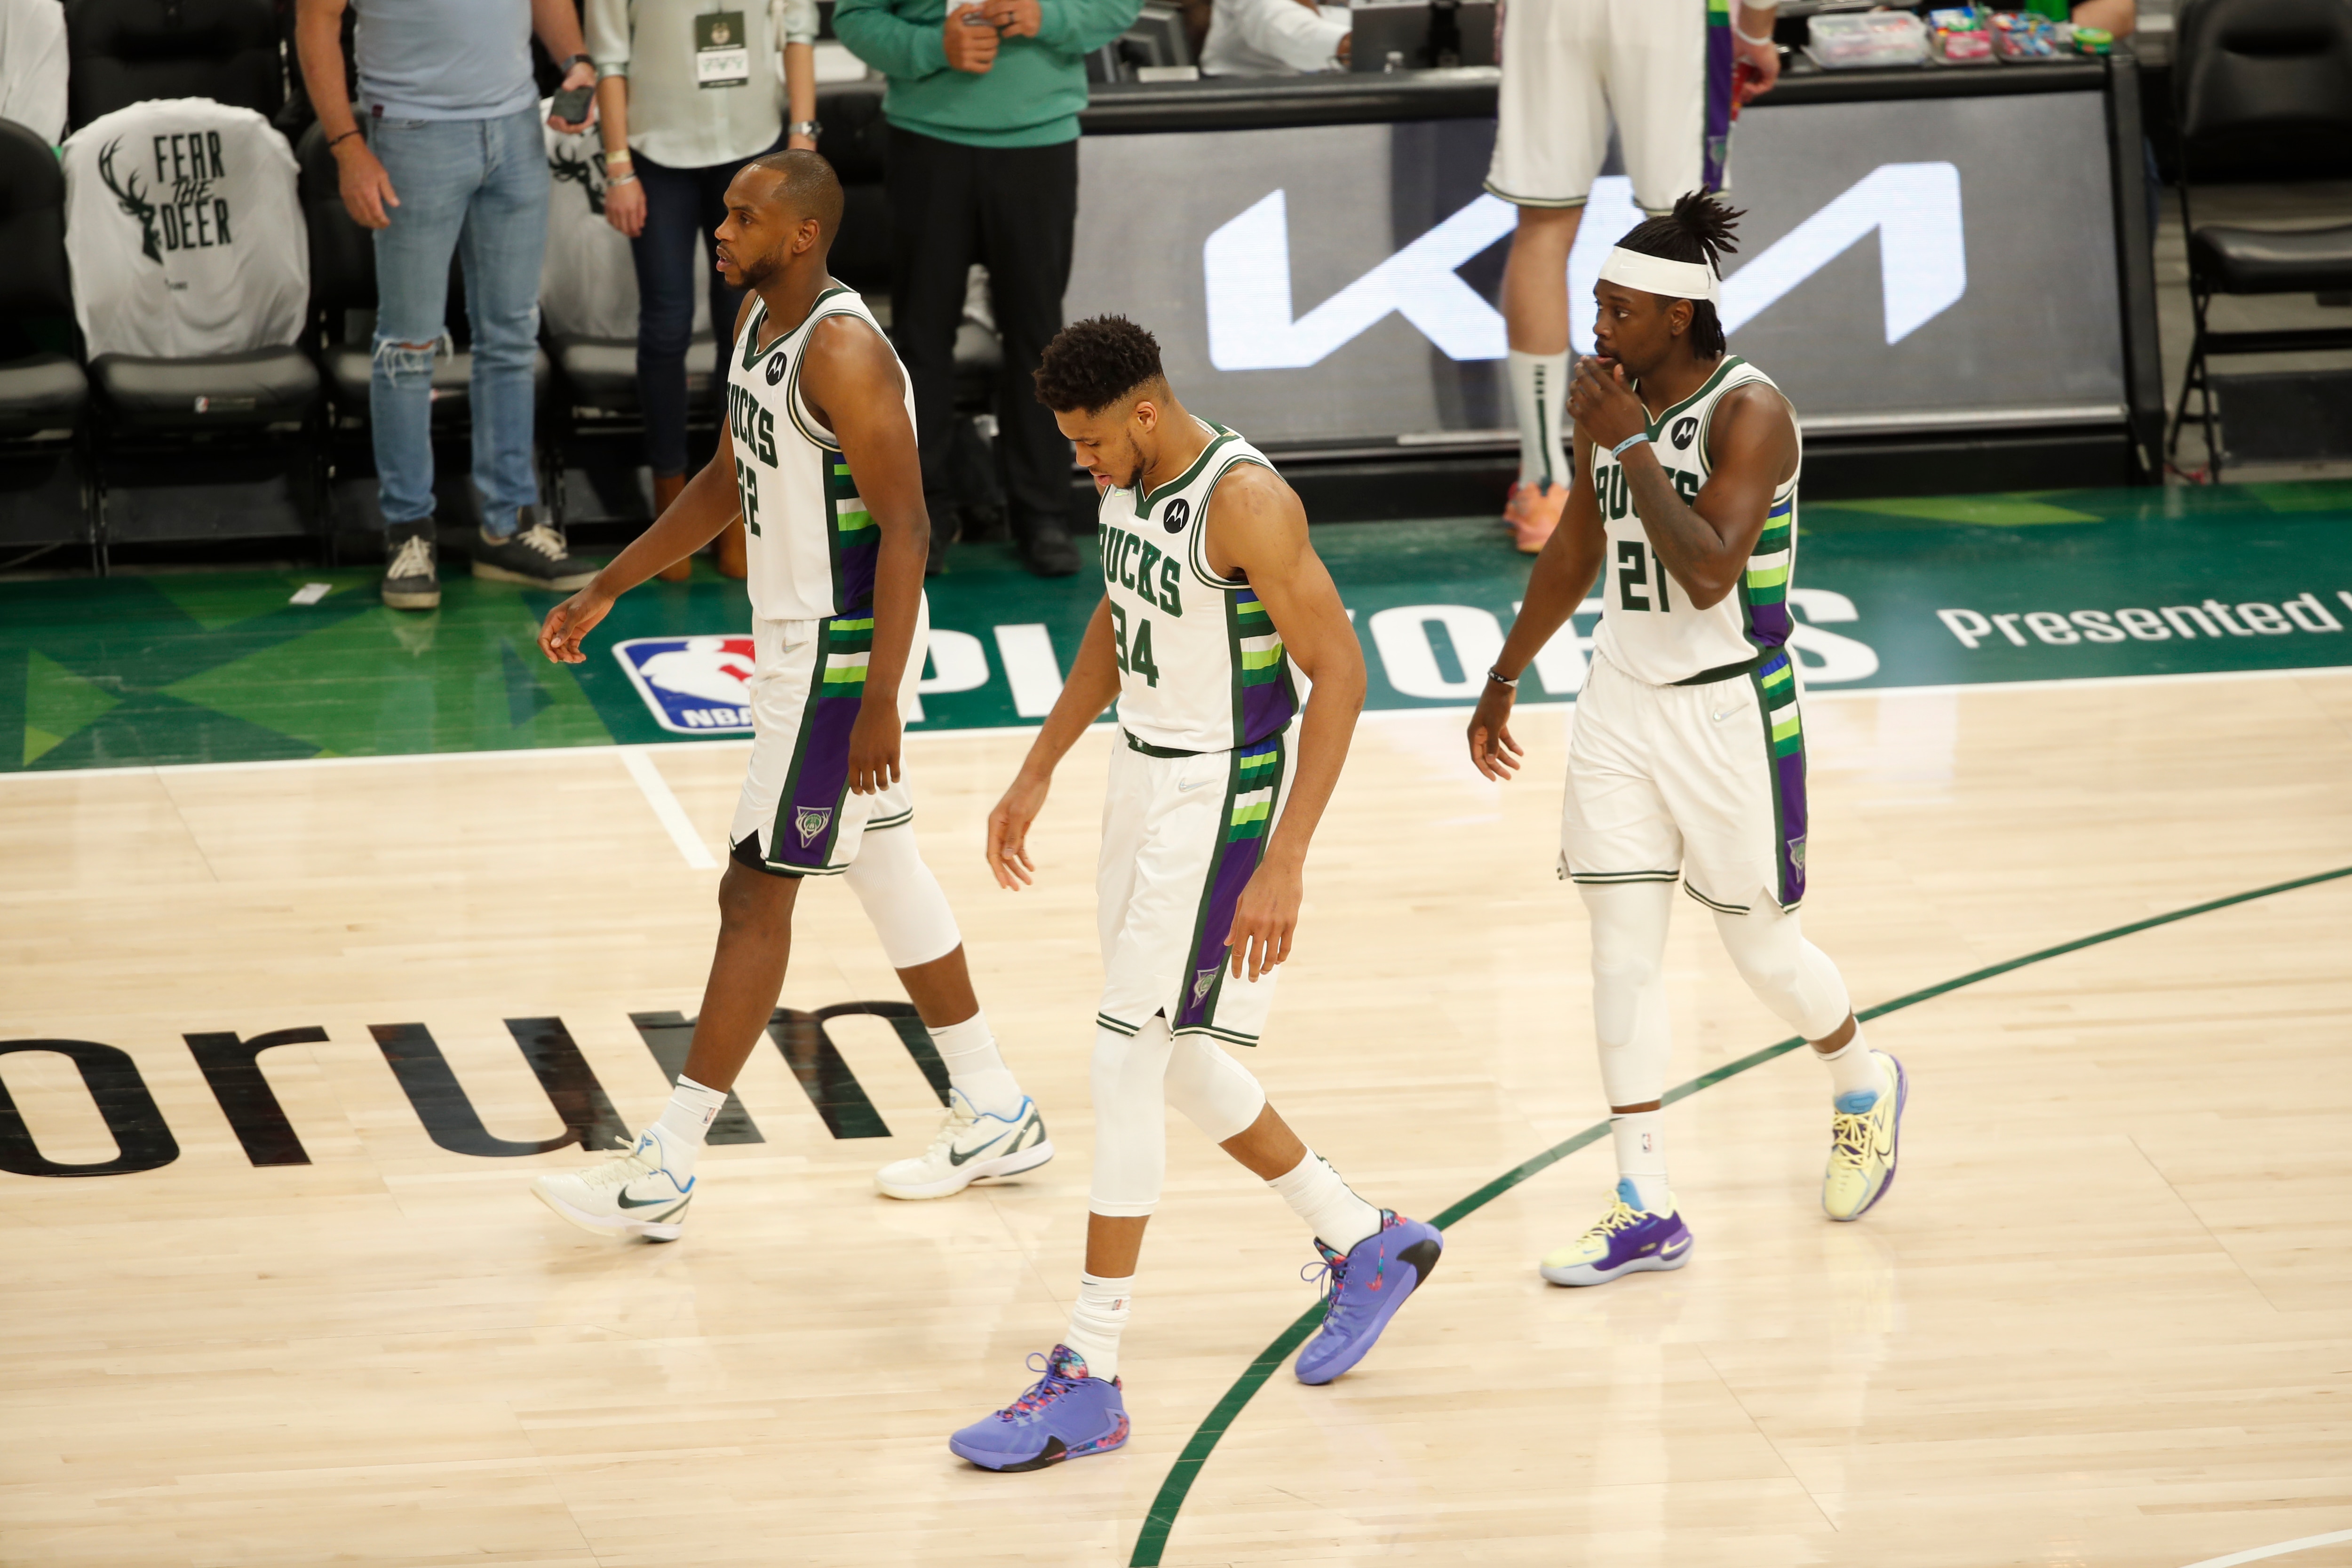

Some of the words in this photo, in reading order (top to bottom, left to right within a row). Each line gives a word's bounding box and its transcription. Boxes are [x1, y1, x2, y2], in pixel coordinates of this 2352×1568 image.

[153, 130, 225, 182] FEAR
[171, 174, 214, 203] THE
[161, 198, 231, 251] DEER
[727, 381, 779, 469] UCKS
[1596, 464, 1699, 527] BUS
[1617, 540, 1670, 613] 21
[1110, 599, 1159, 688] 34
[1936, 592, 2344, 649] Presented
